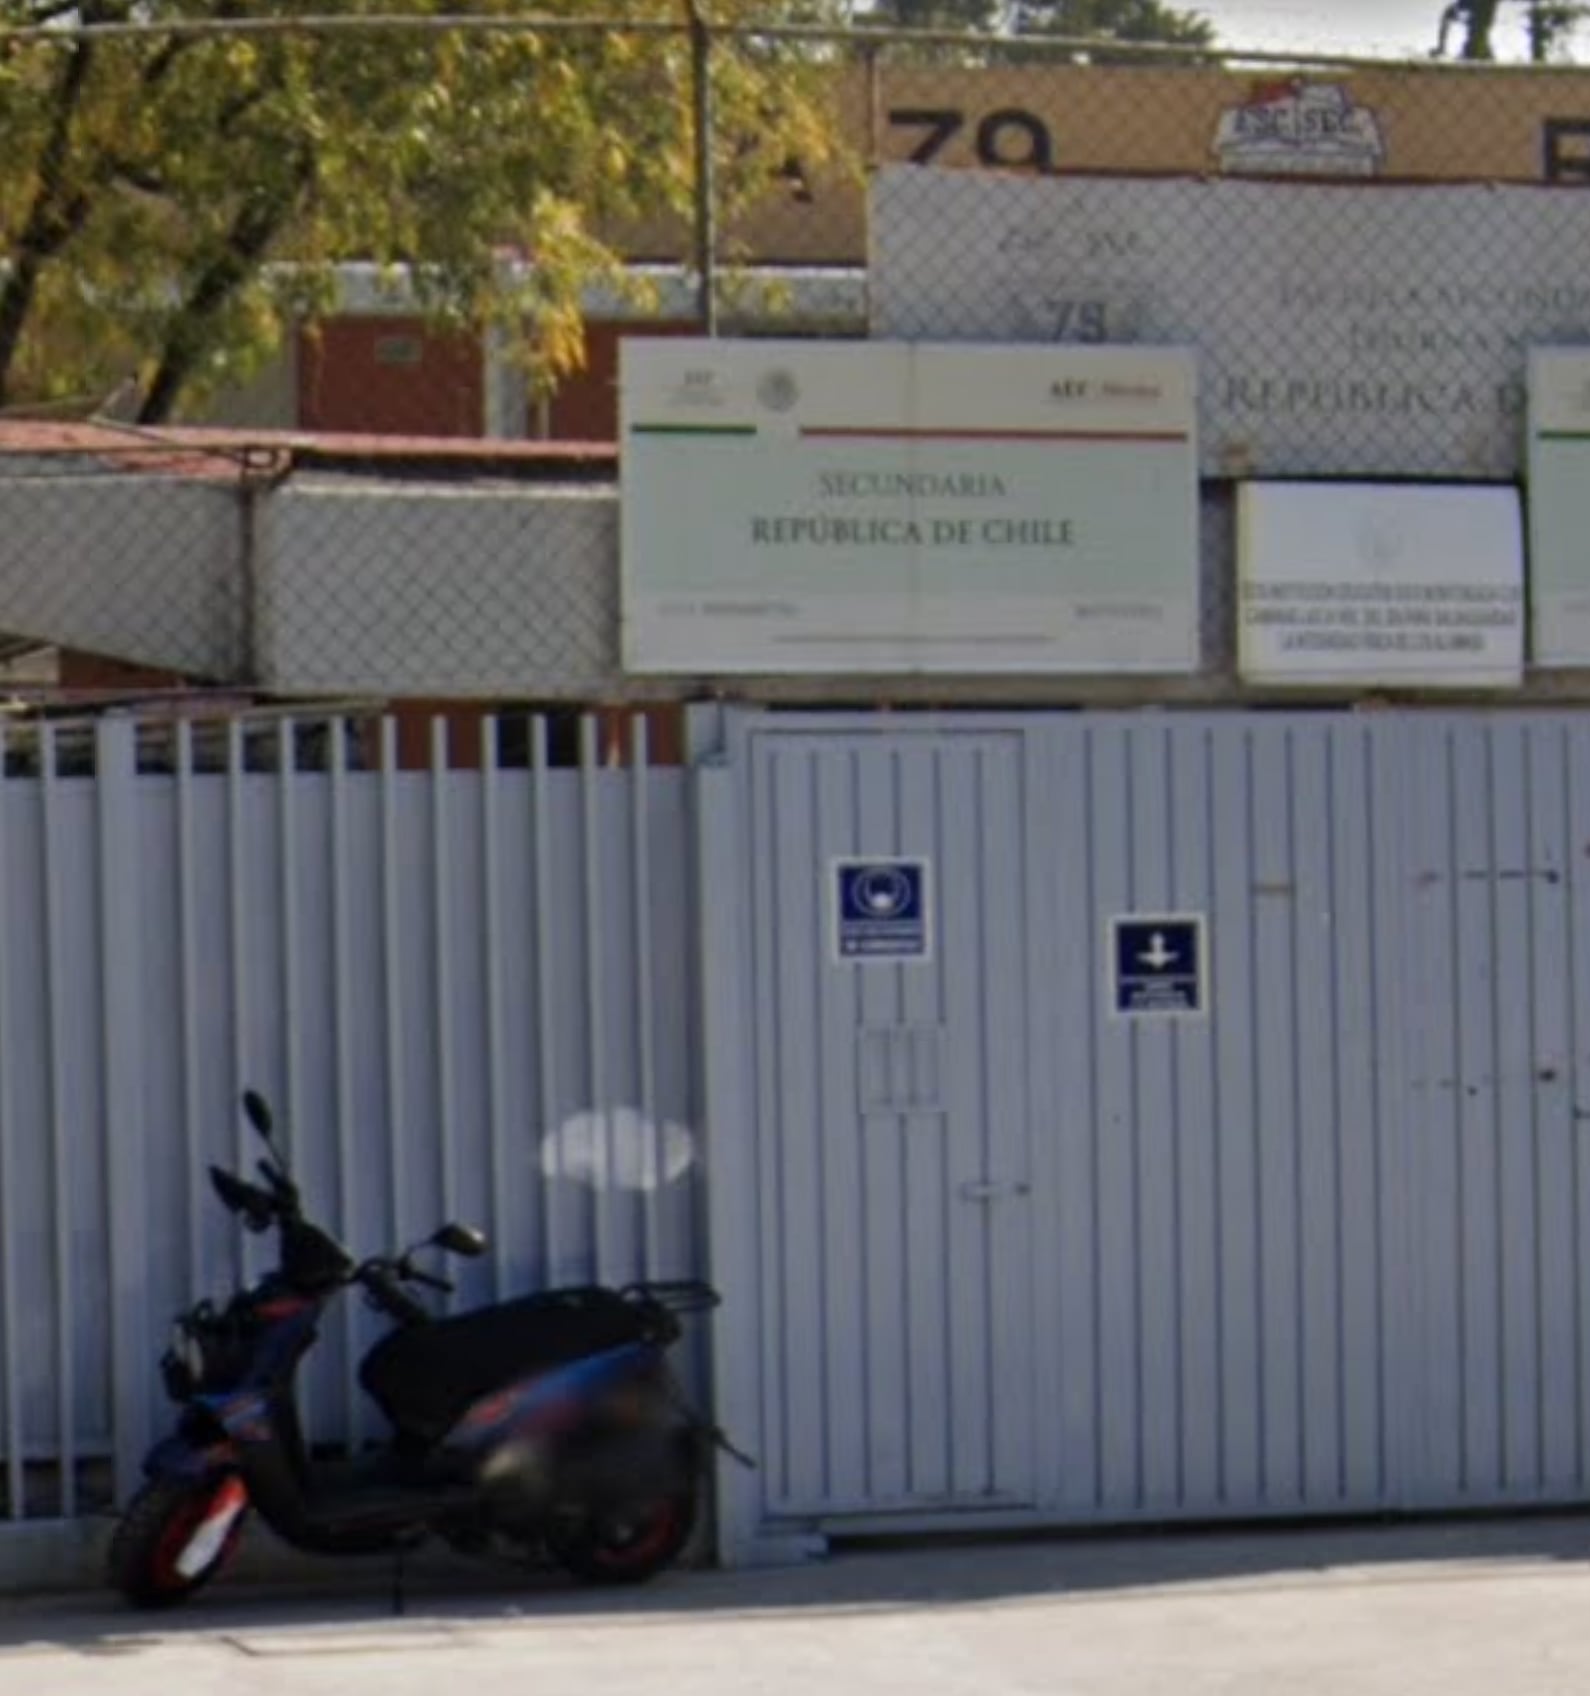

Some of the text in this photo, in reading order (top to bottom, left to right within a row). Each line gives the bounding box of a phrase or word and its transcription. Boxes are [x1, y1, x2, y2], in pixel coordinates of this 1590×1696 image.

[817, 472, 1006, 498] SECUNDARIA
[751, 512, 1074, 547] REPÚBLICA DE CHILE
